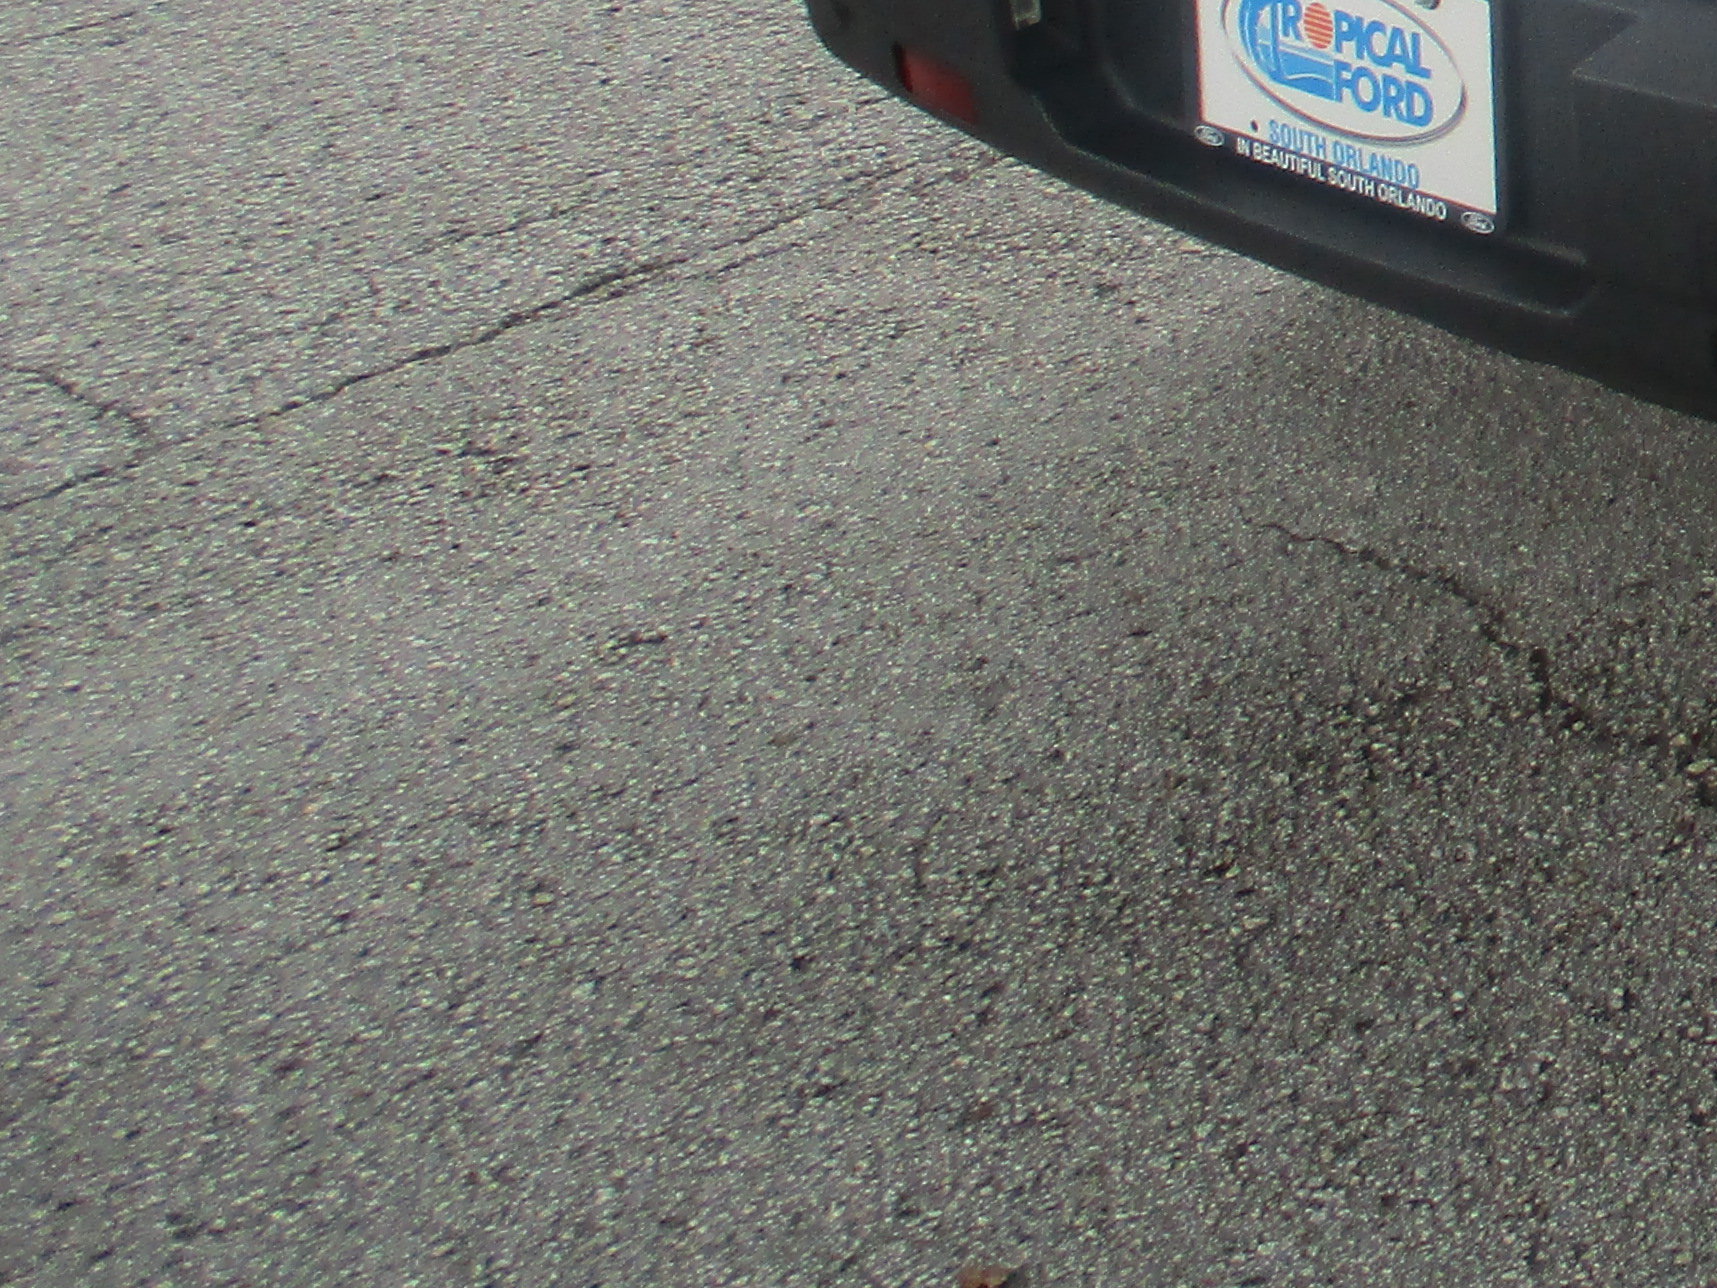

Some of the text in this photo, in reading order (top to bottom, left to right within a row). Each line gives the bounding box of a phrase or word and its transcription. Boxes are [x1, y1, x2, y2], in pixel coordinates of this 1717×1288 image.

[1334, 58, 1435, 128] FORD
[1236, 136, 1251, 157] IN
[1253, 141, 1325, 182] BEAUTIFUL
[1327, 167, 1375, 197] SOUTH
[1377, 182, 1448, 221] ORLANDO
[1268, 119, 1421, 190] SOUTH ORLANDO
